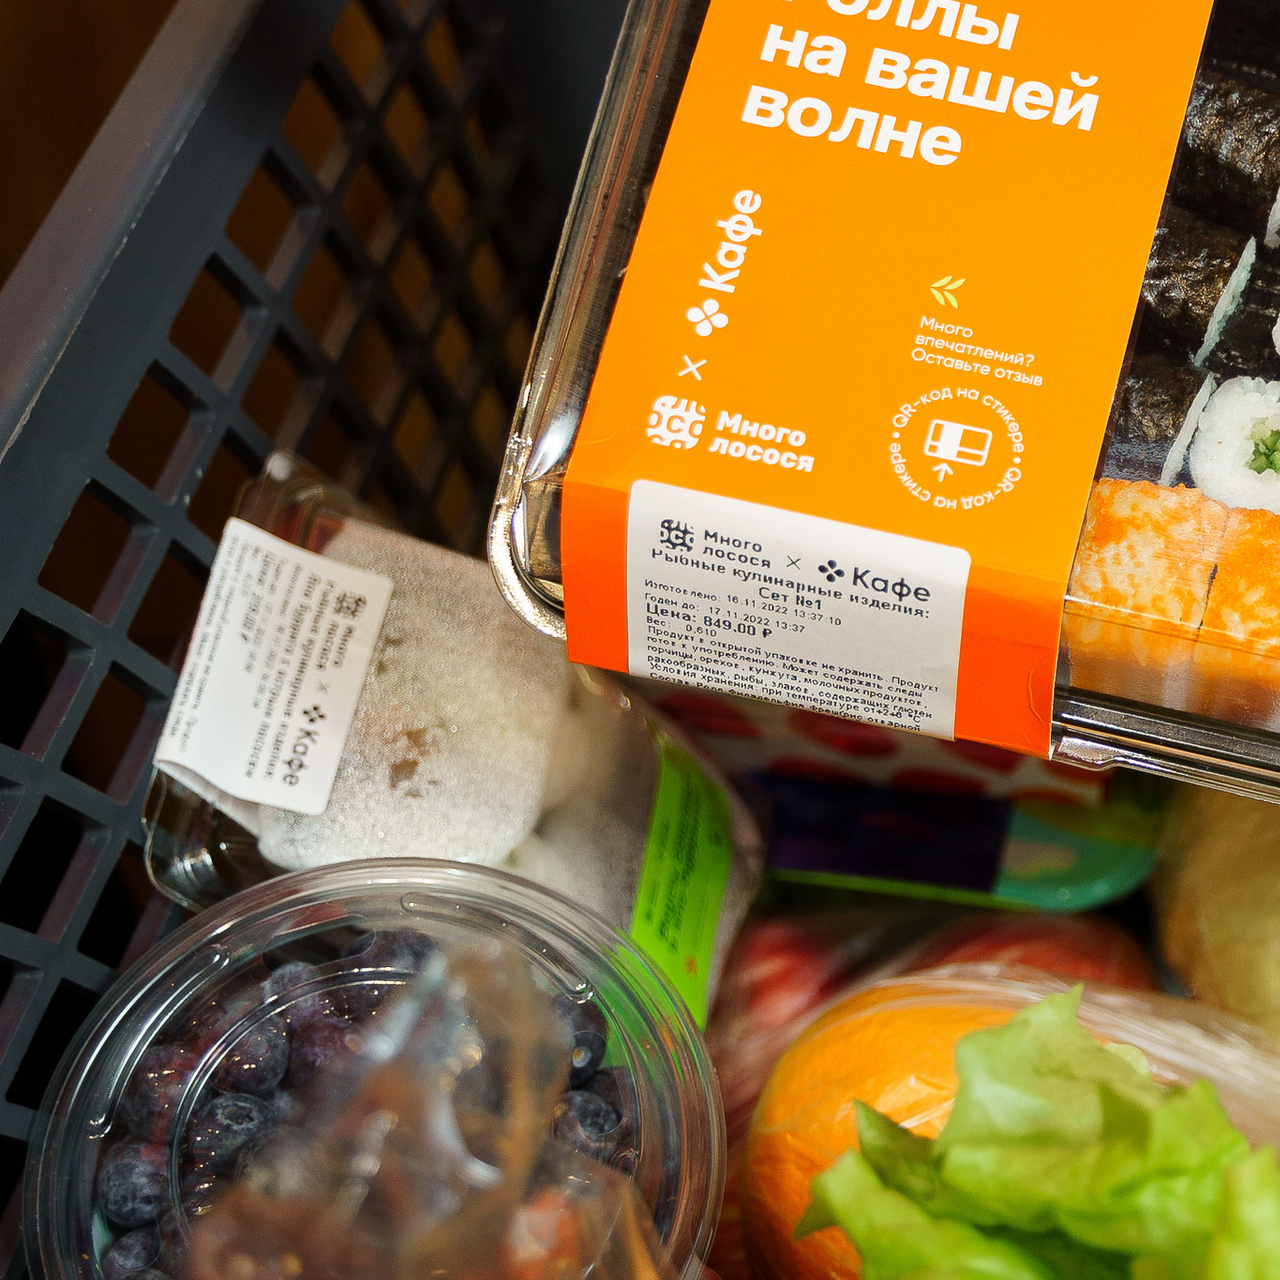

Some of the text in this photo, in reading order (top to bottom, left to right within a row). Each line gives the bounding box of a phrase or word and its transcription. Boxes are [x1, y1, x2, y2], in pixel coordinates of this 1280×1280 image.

[760, 23, 1100, 131] на вашей
[741, 84, 963, 166] волне
[699, 189, 763, 294] Кафе
[919, 315, 974, 339] Много
[911, 347, 1044, 387] Оставьте отзыв
[915, 334, 1036, 368] впечатлений?
[716, 410, 807, 447] Много
[892, 387, 1025, 454] QR-код на стикере
[709, 437, 815, 473] лосося
[889, 442, 1022, 510] QR-код на стикере
[703, 546, 771, 569] лосося
[704, 529, 763, 553] Много
[651, 548, 930, 619] Рыбные кулинарные изделия:
[758, 586, 823, 611] Сет №1
[852, 566, 931, 603] Кафе
[644, 578, 842, 627] Изготовлено: 16.11.2022 13:37:10
[644, 592, 806, 634] Годен до: 17.11.2022 13:37
[646, 602, 697, 623] Цена:
[703, 615, 757, 636] 849.00
[646, 615, 672, 628] Вес:
[648, 625, 695, 642] Продукт
[710, 639, 762, 656] открытой
[764, 650, 818, 668] упаковке
[891, 675, 940, 693] Продукт
[761, 687, 783, 697] при
[786, 692, 860, 712] температуре
[804, 678, 861, 695] молочных
[823, 672, 884, 690] содержать
[887, 686, 923, 698] следы
[818, 690, 890, 710] содержащих
[893, 705, 932, 719] глютен
[282, 726, 320, 787] Кафе
